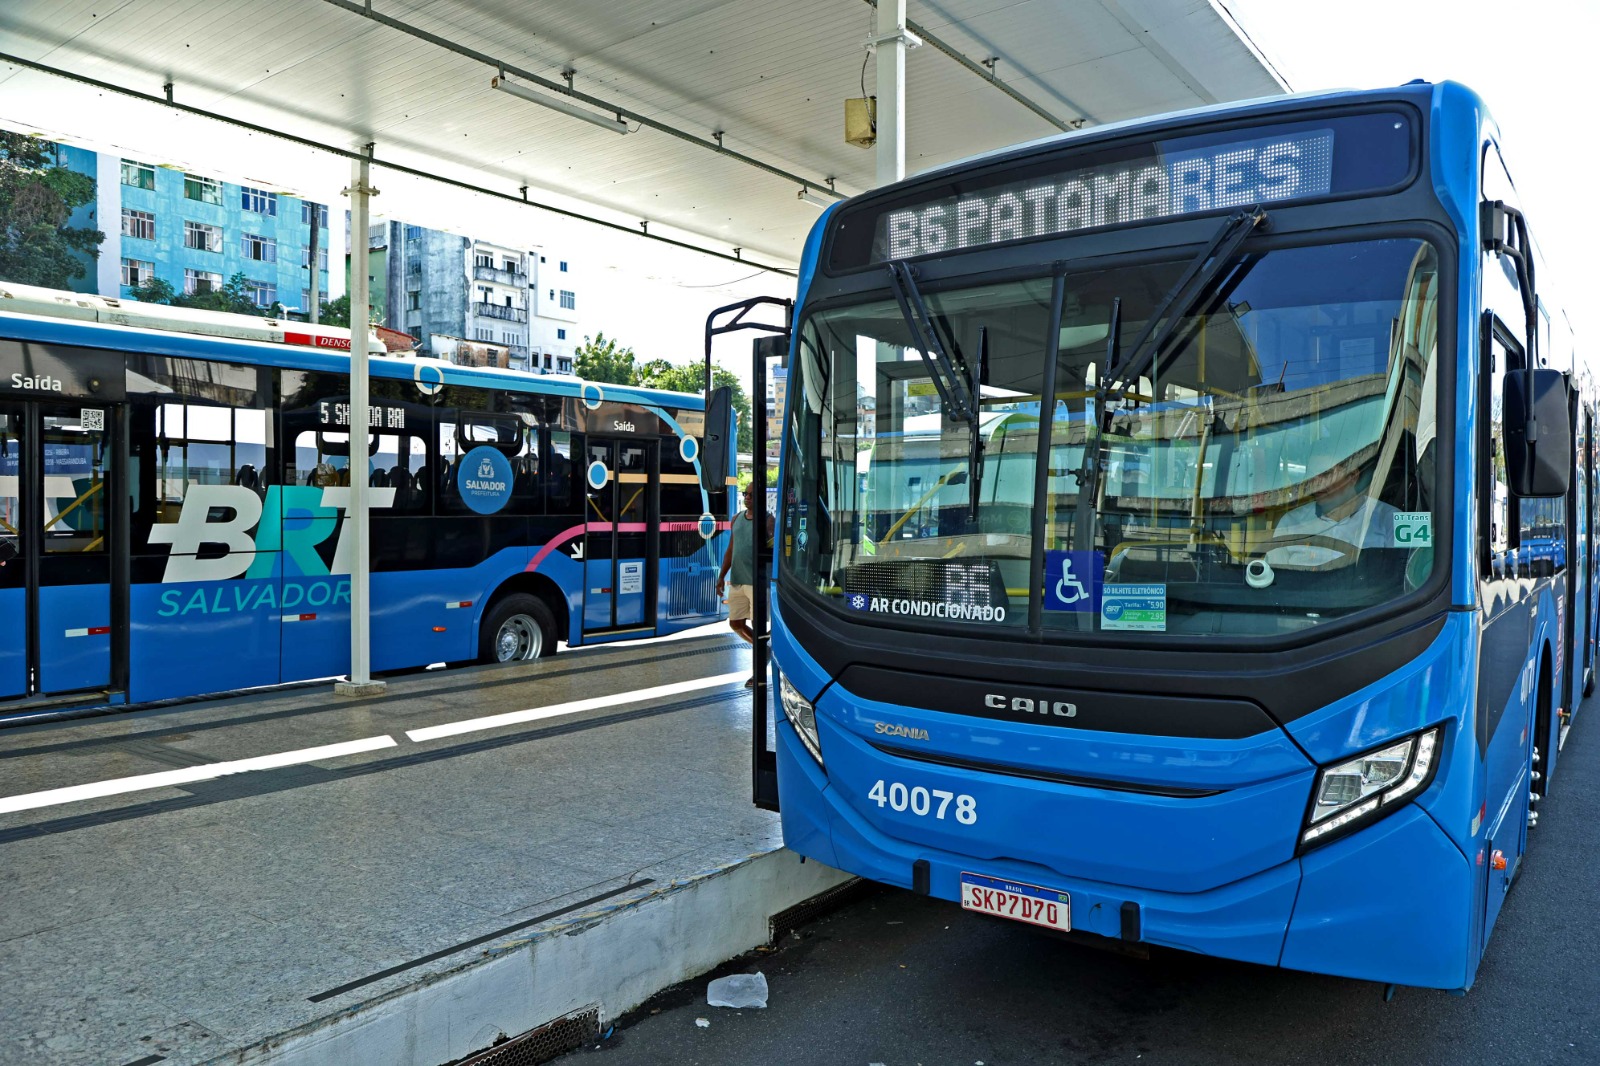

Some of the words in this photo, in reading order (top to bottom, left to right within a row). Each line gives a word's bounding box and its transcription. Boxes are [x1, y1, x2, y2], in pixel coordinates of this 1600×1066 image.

[888, 209, 948, 260] B6
[957, 142, 1300, 247] PATAMARES
[11, 372, 62, 392] Saída
[320, 401, 329, 424] 5
[613, 420, 635, 433] Saída
[465, 479, 506, 491] SALVADOR
[470, 489, 500, 497] PREFEITURA
[147, 484, 397, 584] BRT
[1394, 524, 1430, 542] G4
[157, 580, 351, 617] SALVADOR
[1132, 586, 1164, 594] ELETRÔNICO
[870, 597, 889, 613] AR
[891, 599, 1006, 622] CONDICIONADO
[984, 693, 1077, 718] CAIO
[874, 722, 930, 741] SCANIA
[867, 779, 978, 825] 40078
[1005, 884, 1023, 893] BRASIL
[971, 887, 1058, 925] SKP7D70
